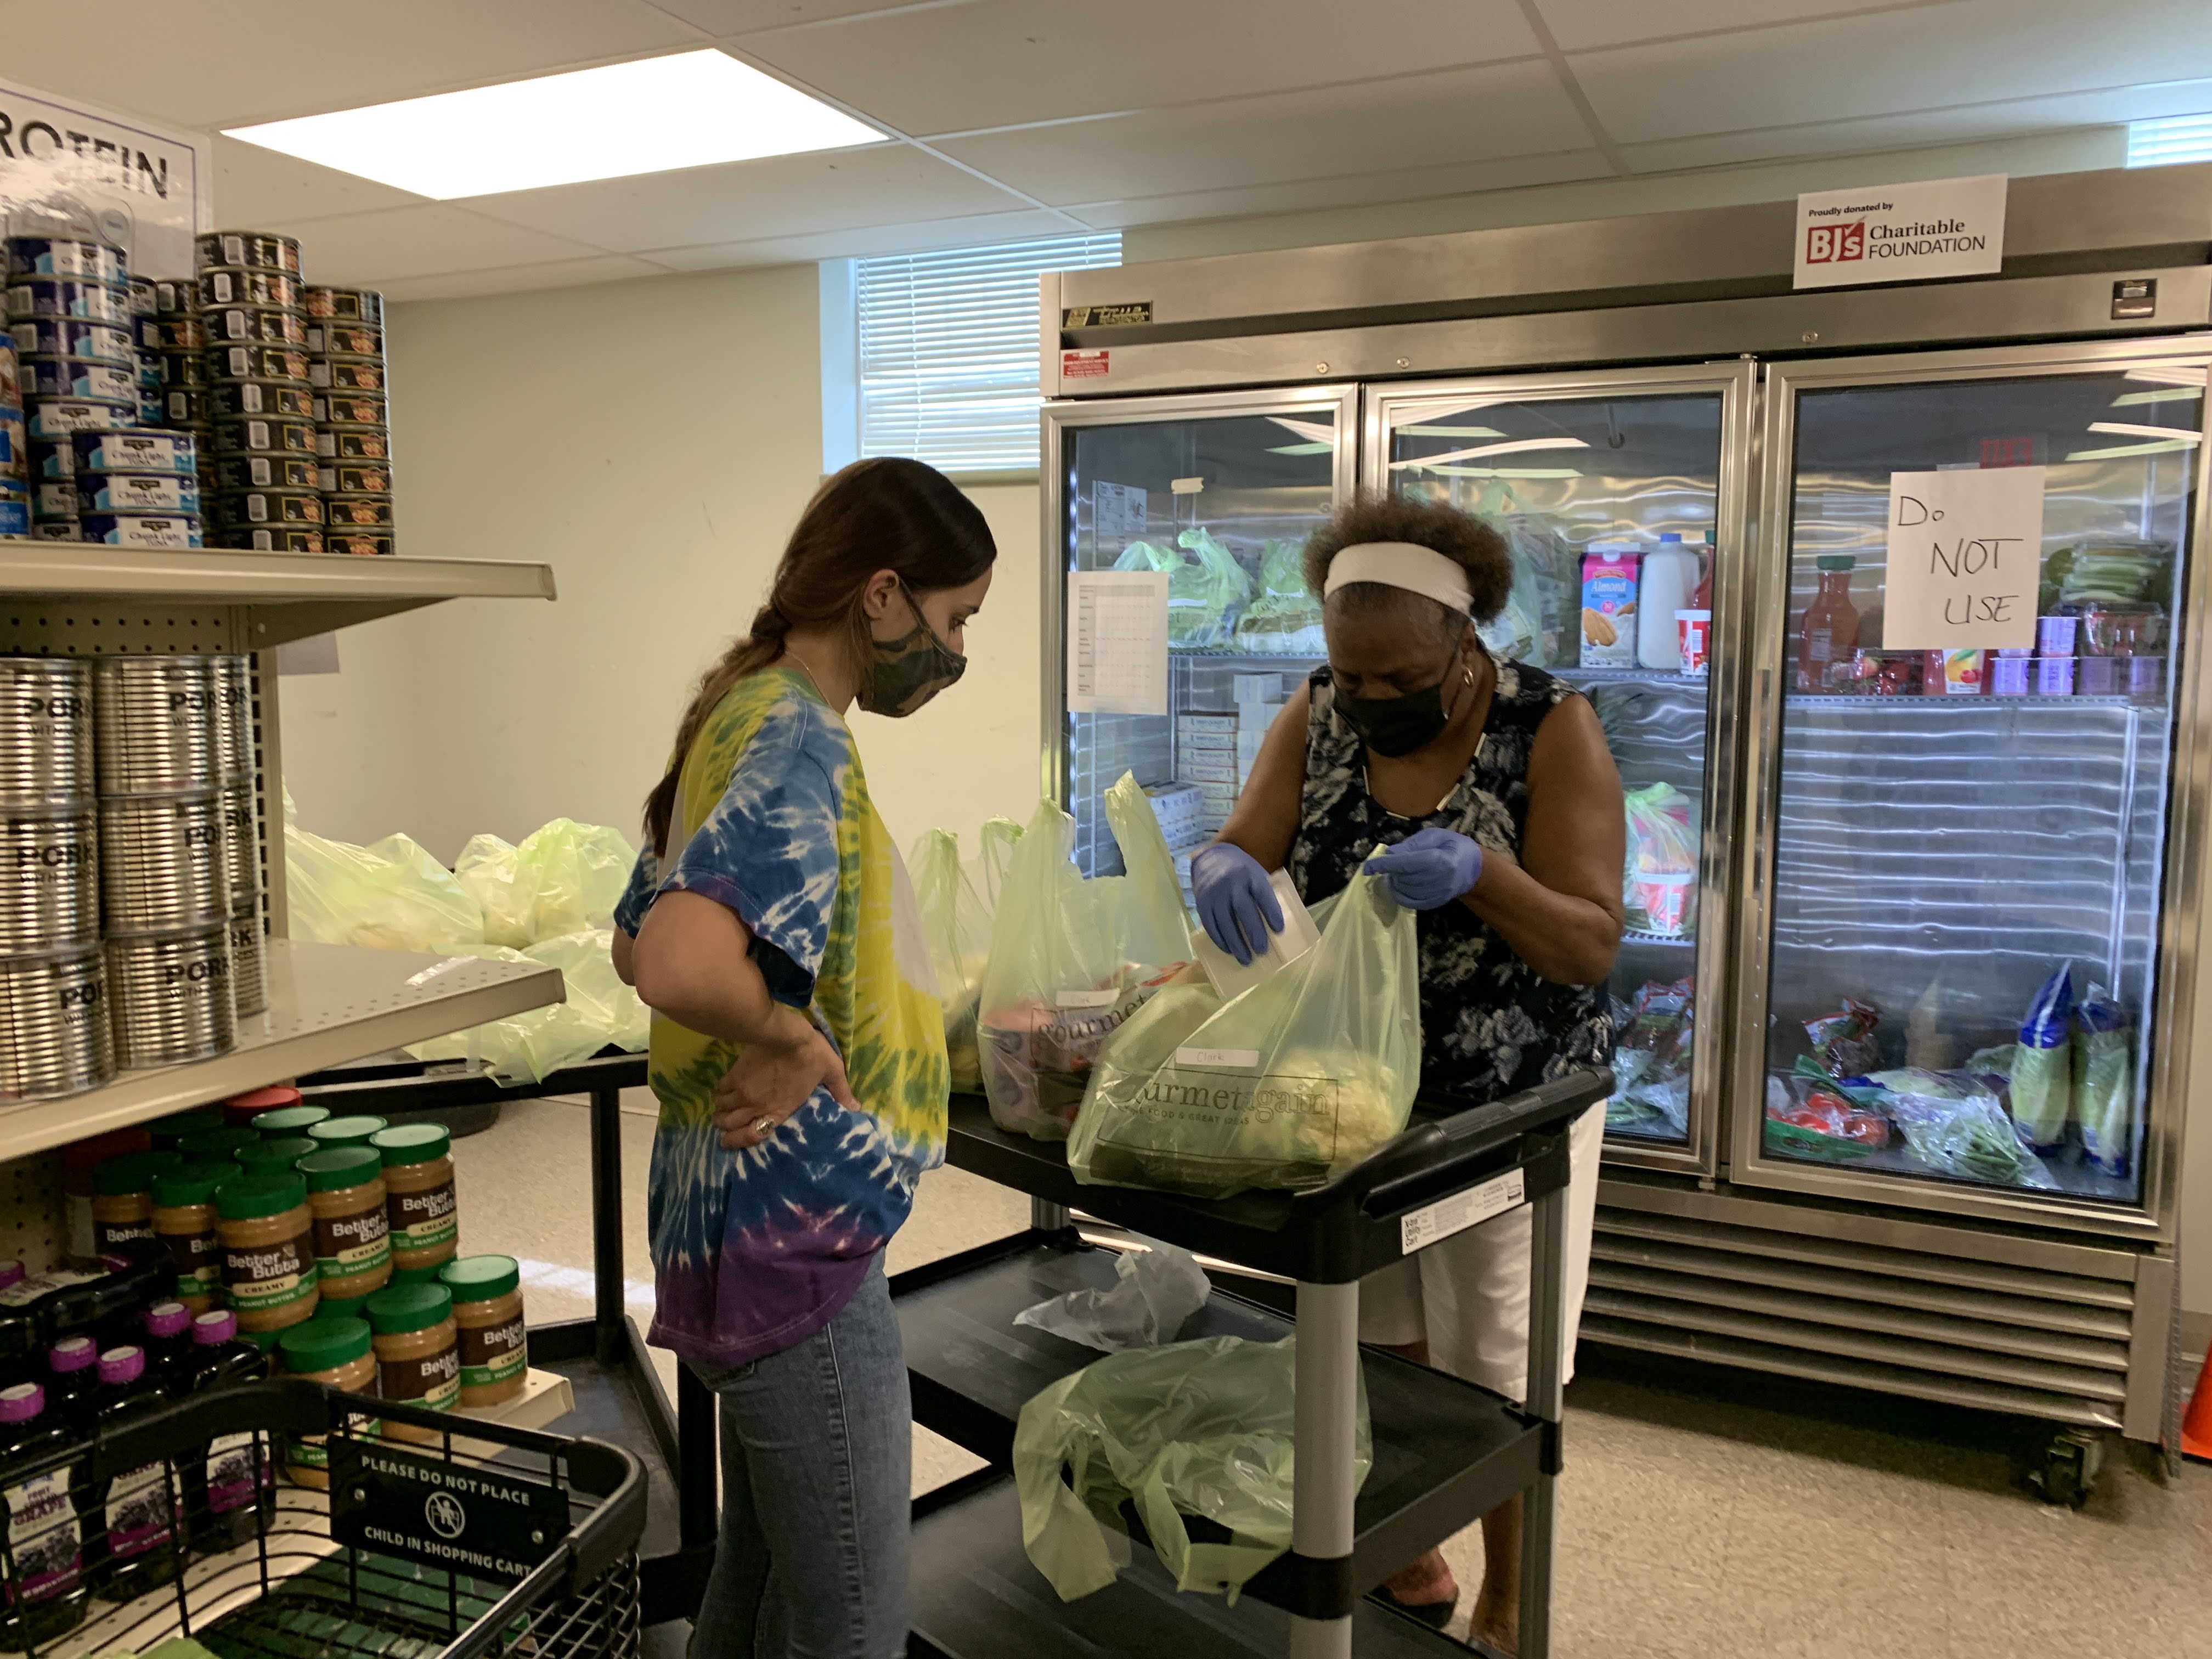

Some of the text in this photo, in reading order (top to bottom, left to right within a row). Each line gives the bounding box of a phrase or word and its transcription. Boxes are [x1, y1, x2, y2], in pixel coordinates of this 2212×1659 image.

[0, 111, 167, 199] ROTEIN
[1809, 202, 1894, 217] Proudly donated by
[1870, 219, 1965, 240] Charitable
[1869, 235, 1985, 259] FOUNDATION
[1898, 495, 1944, 526] Do
[1930, 538, 2024, 577] NOT
[1945, 594, 2019, 624] USE
[24, 697, 82, 719] POR
[1038, 992, 1151, 1049] gourmet
[1188, 1113, 1221, 1124] GREAT
[228, 1252, 281, 1269] Better
[252, 1259, 300, 1279] Bubba
[245, 1282, 285, 1294] CREAMY
[238, 1293, 295, 1307] PEANUT BUTTER
[361, 1455, 530, 1506] PLEASE DO NOT PLACE
[364, 1526, 531, 1577] CHILD IN SHOPPING CART
